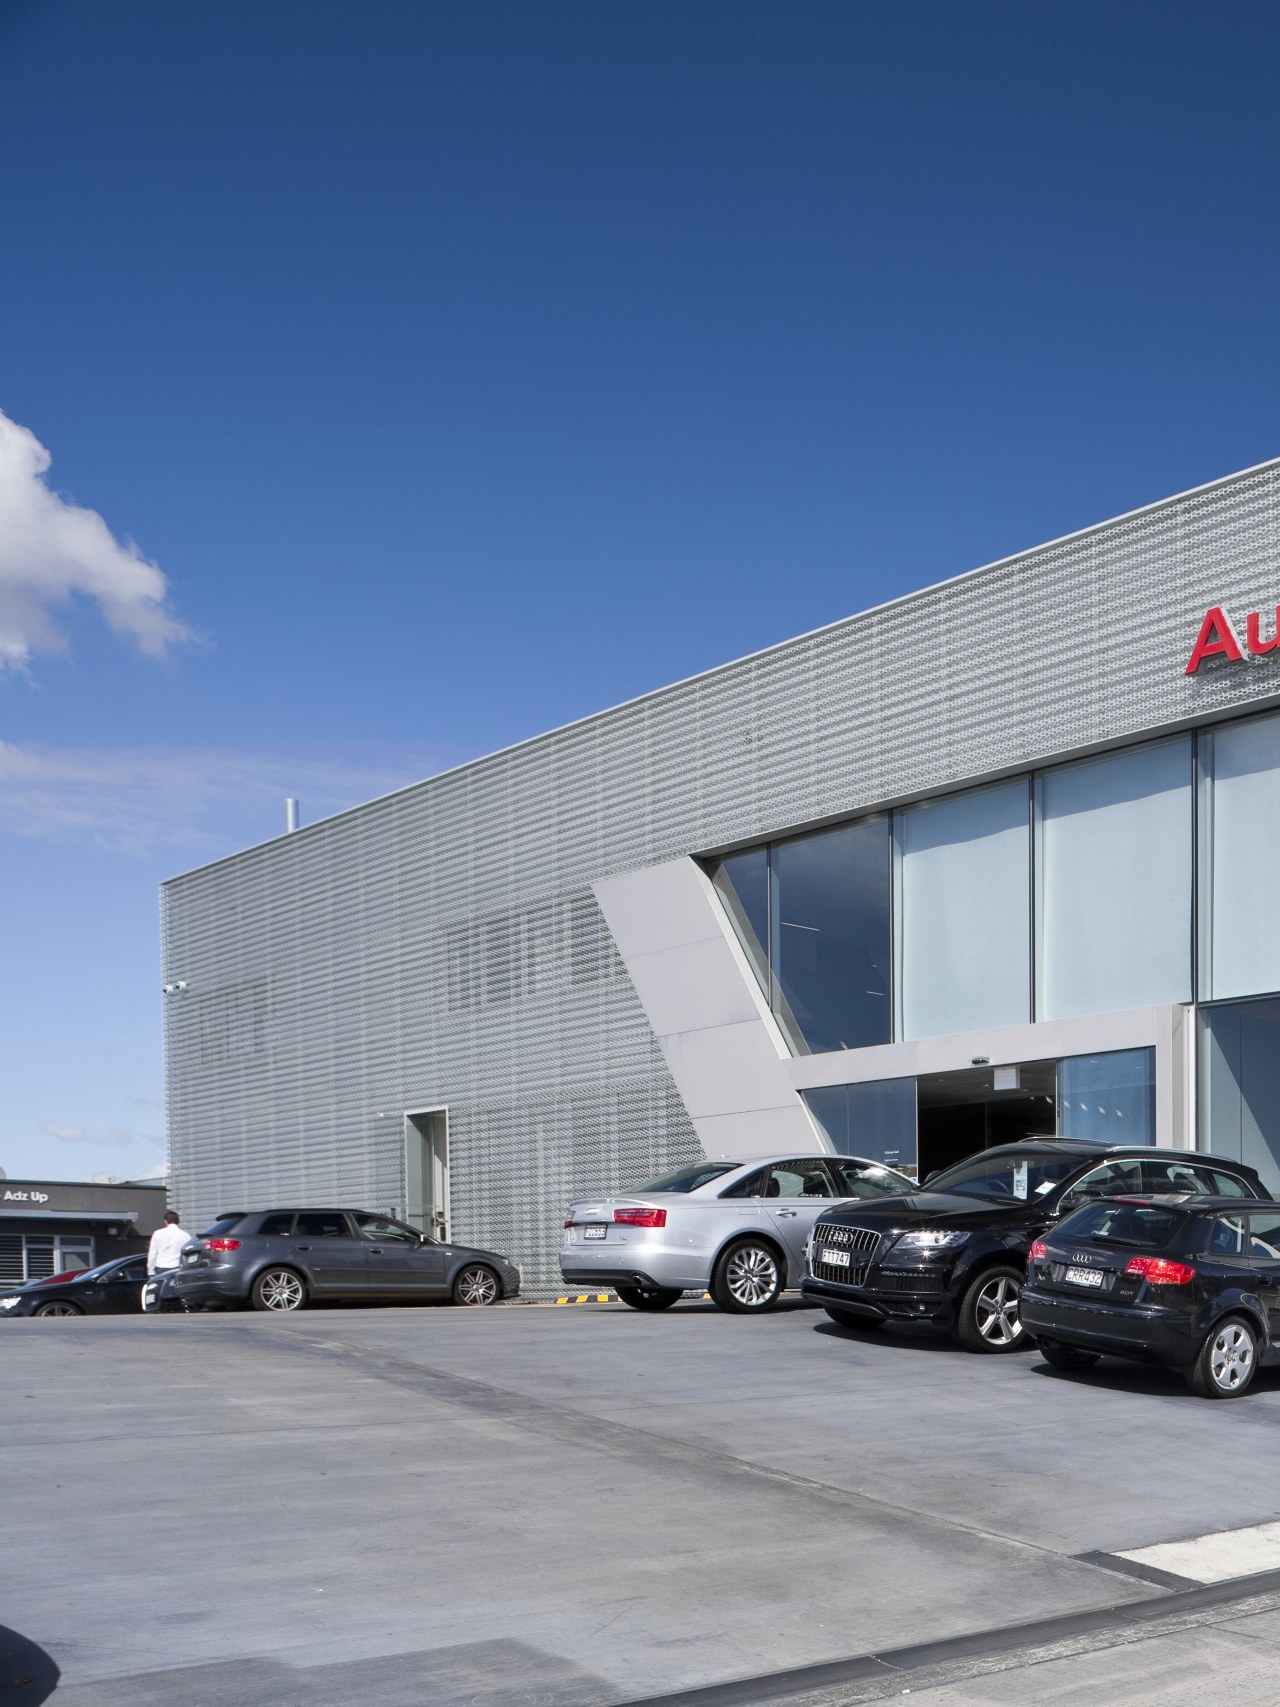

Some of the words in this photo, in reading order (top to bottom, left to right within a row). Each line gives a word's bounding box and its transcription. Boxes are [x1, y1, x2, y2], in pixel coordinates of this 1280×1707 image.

[3, 1190, 29, 1201] Adz
[30, 1191, 49, 1204] Up
[823, 1250, 850, 1265] FTT747
[1066, 1267, 1103, 1285] CRR432
